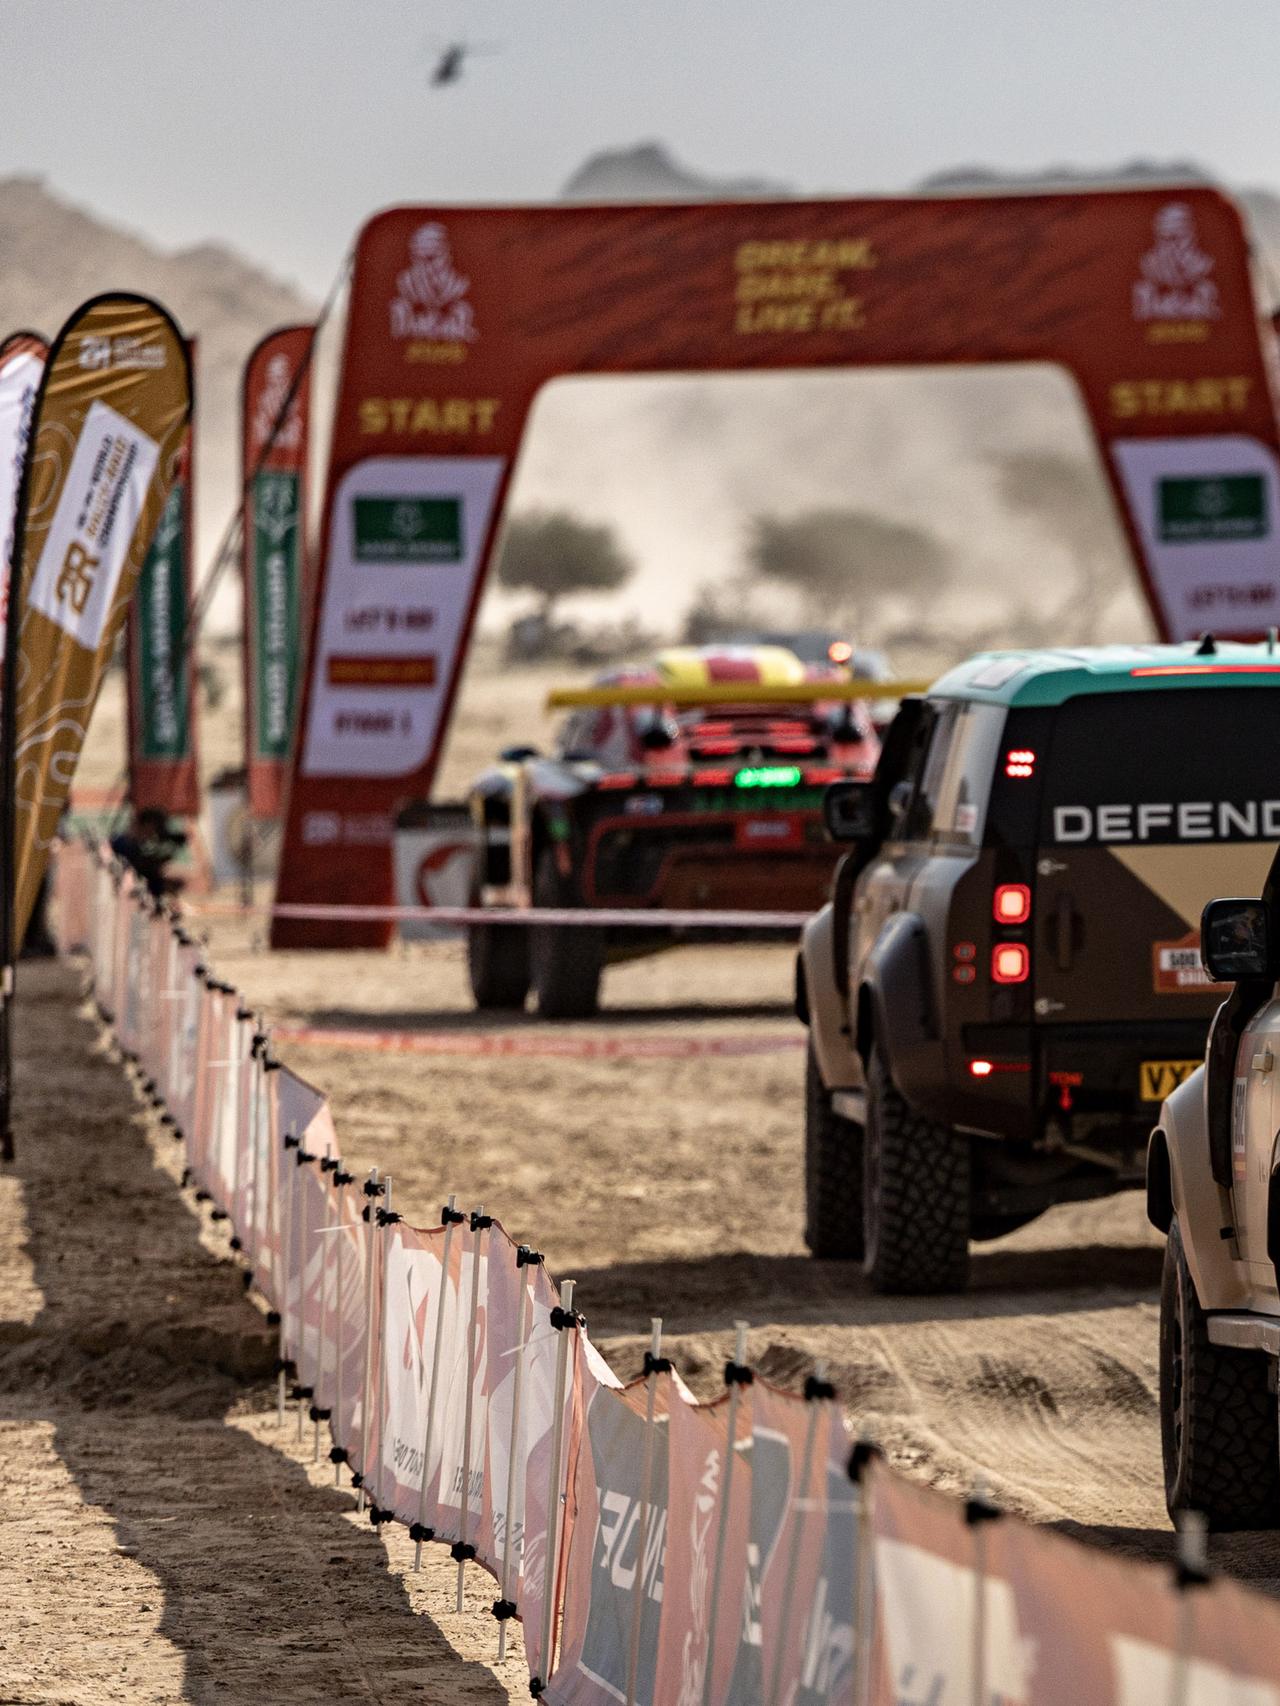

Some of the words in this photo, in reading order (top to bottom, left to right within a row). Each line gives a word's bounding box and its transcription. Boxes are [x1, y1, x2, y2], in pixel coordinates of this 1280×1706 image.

[736, 301, 812, 335] LIVE
[1109, 376, 1251, 418] START
[359, 398, 501, 434] START
